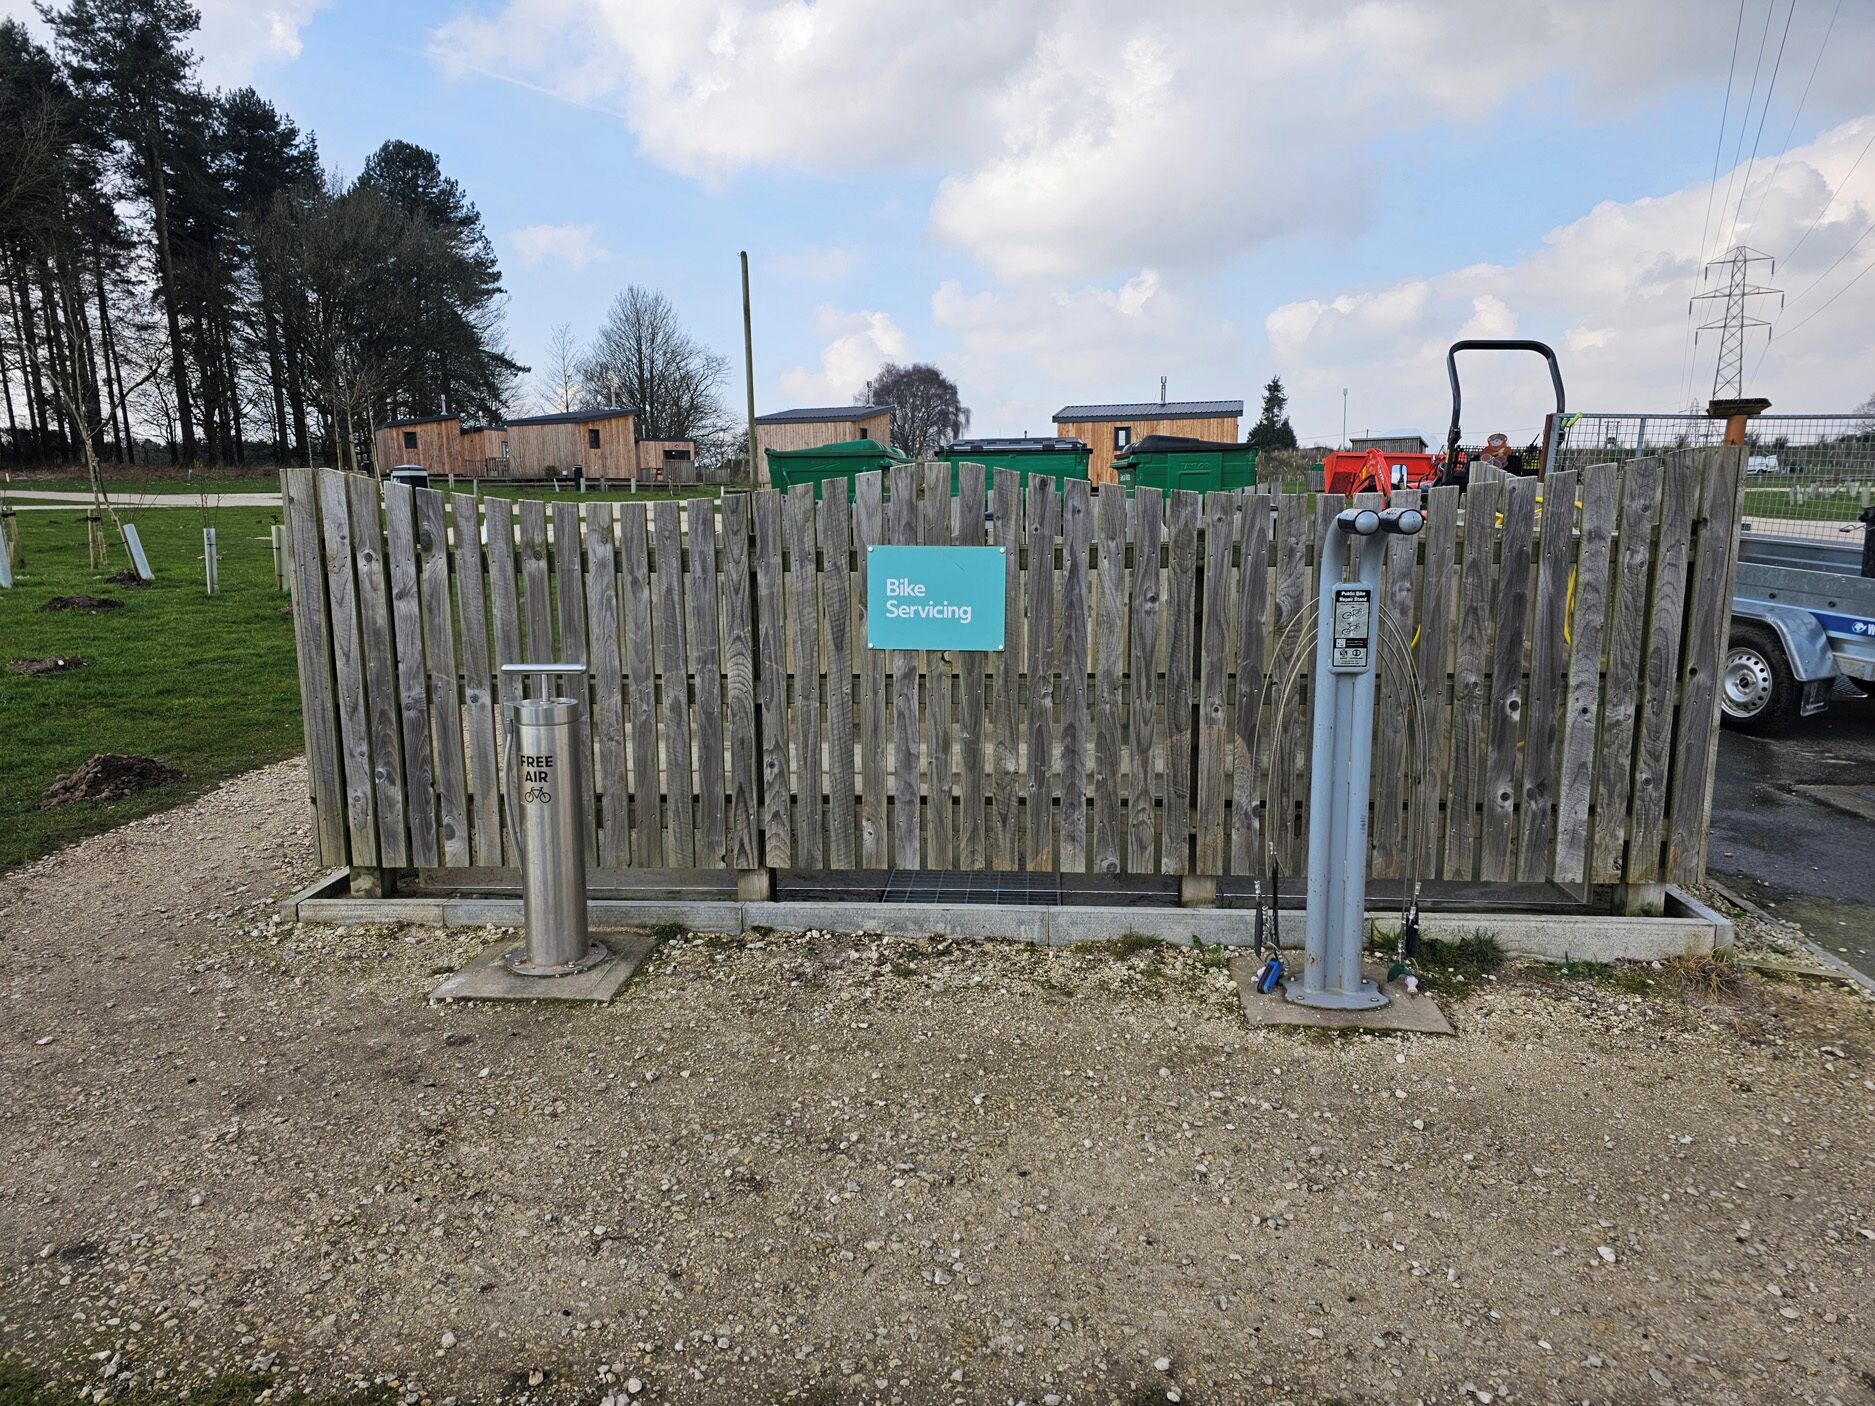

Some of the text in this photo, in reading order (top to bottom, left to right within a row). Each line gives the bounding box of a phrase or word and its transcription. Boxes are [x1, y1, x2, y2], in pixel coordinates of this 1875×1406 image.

[886, 578, 926, 597] Bike
[886, 600, 972, 624] Servicing
[520, 755, 553, 768] FREE
[525, 771, 548, 783] AIR
